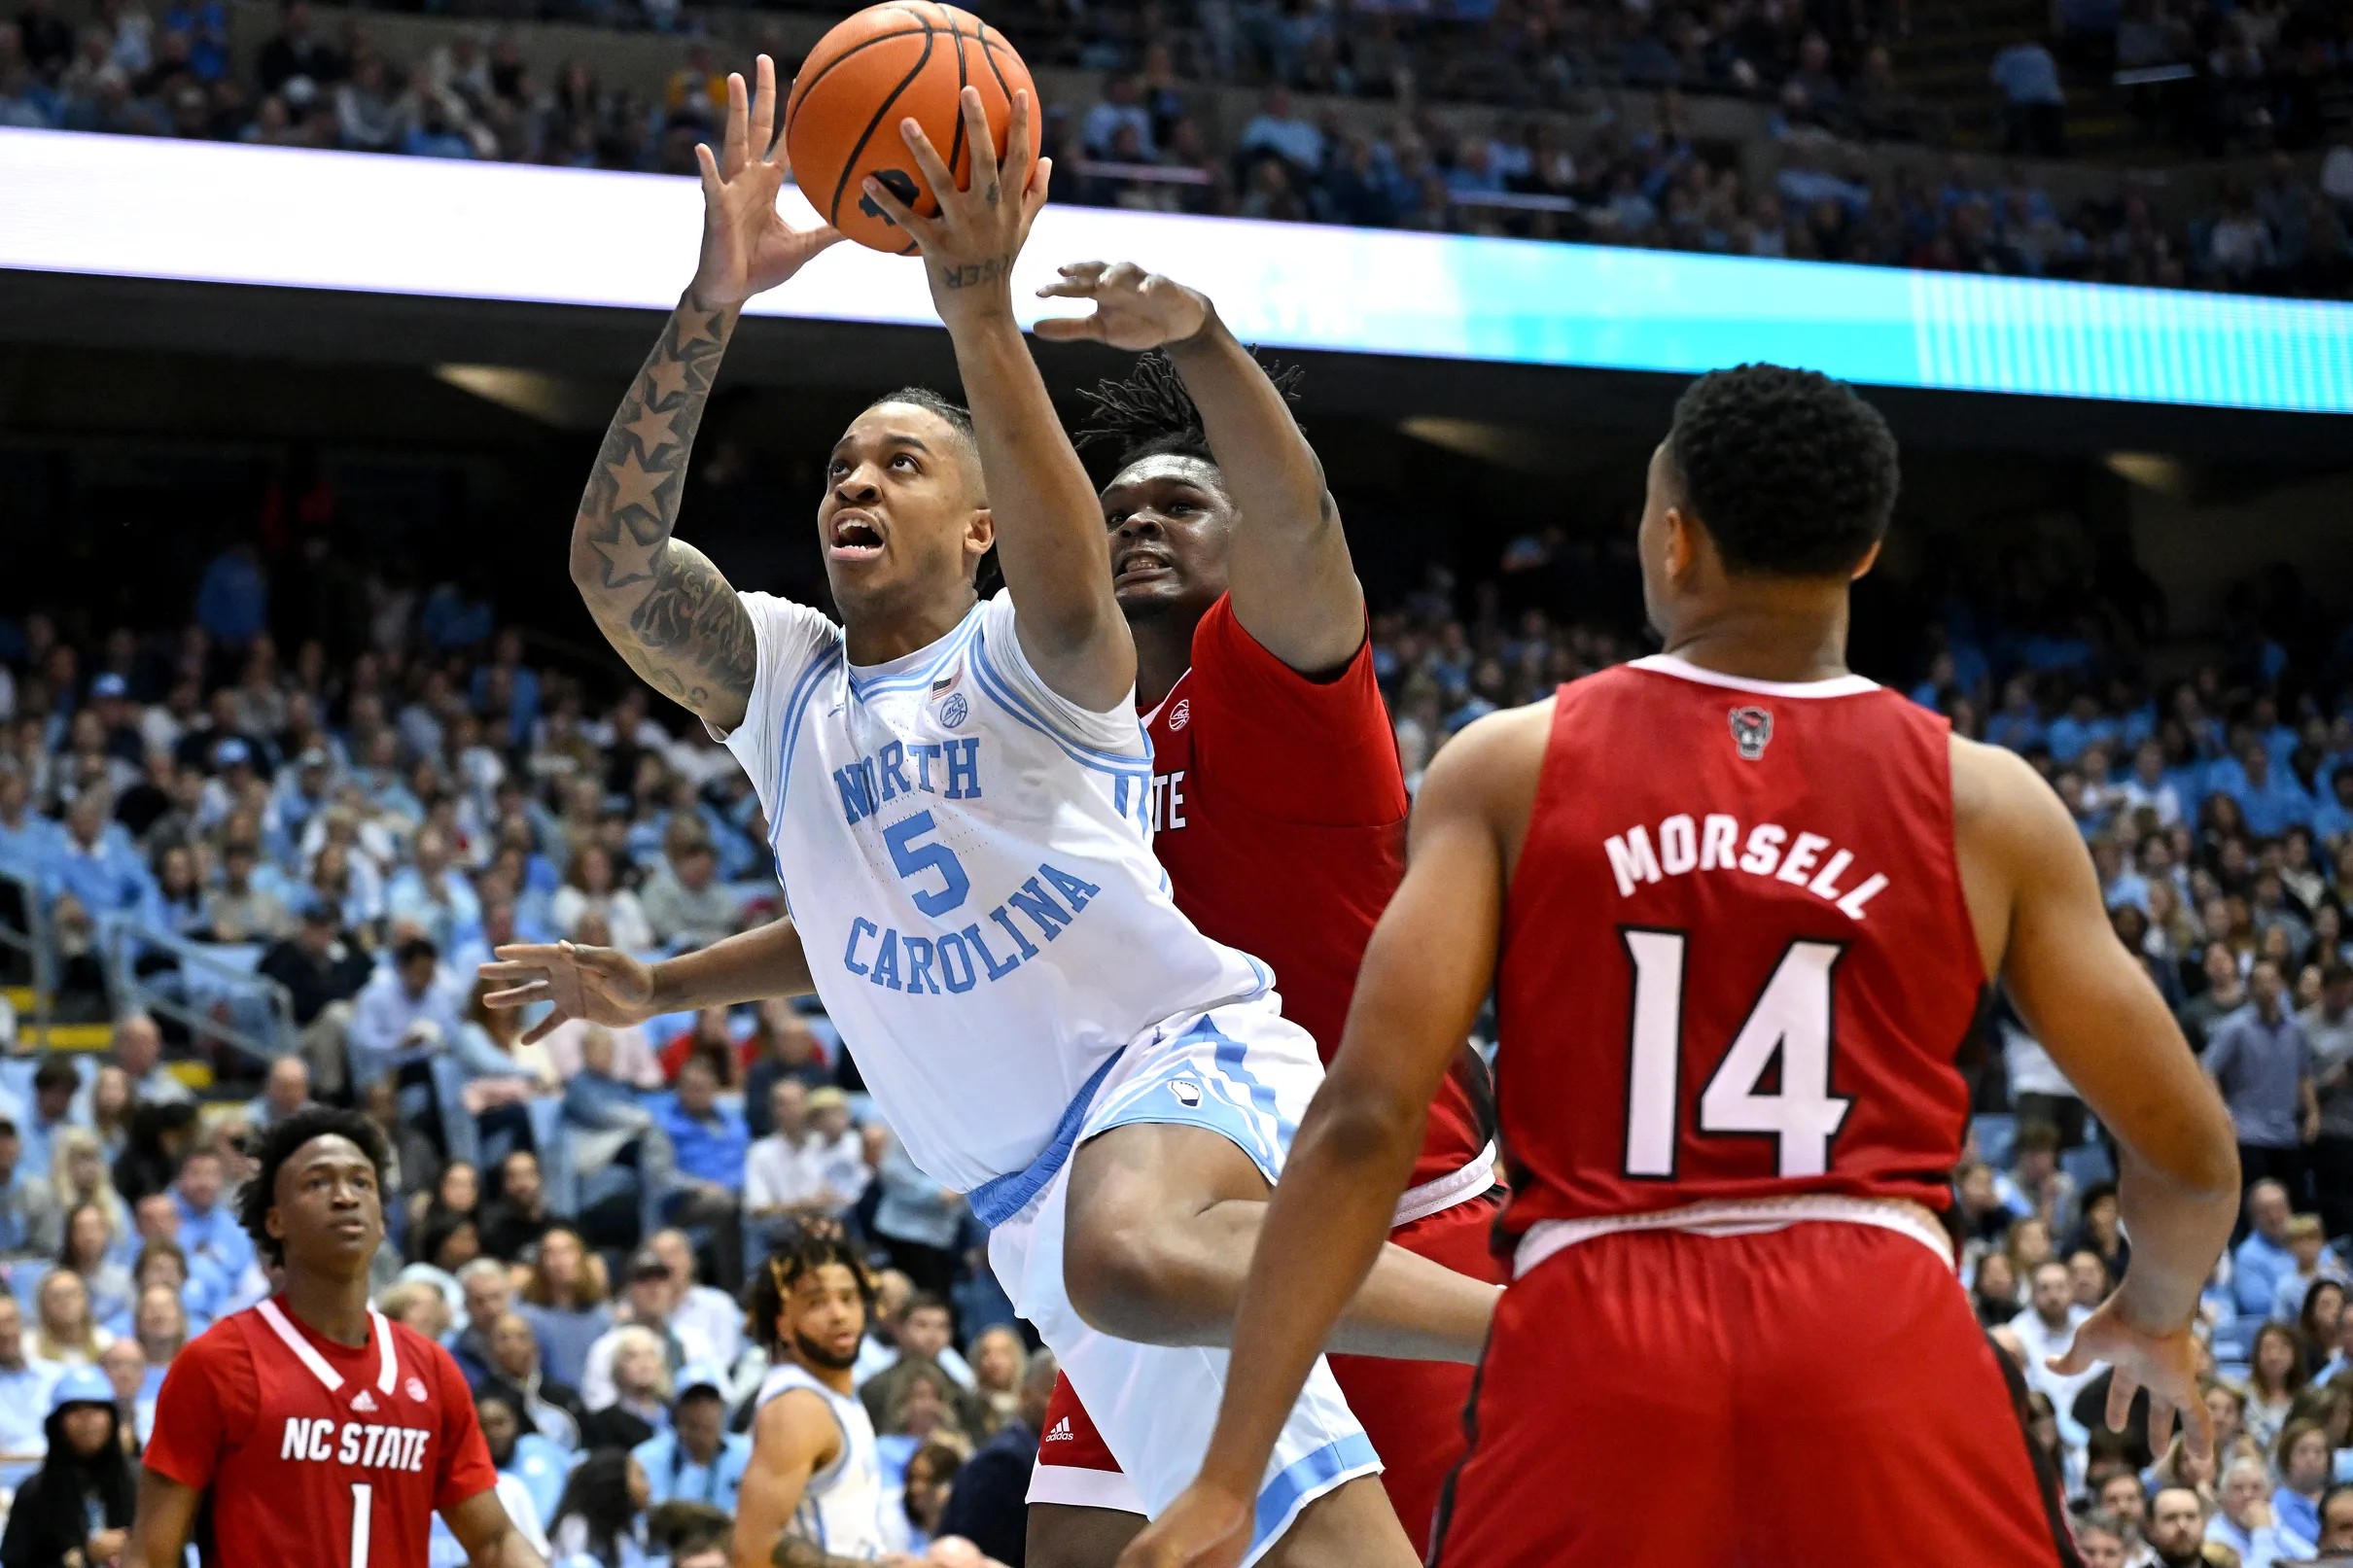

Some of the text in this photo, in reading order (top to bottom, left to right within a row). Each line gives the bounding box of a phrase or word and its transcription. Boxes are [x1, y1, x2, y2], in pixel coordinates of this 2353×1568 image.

[944, 700, 964, 717] ACC
[833, 737, 981, 825] NORTH
[882, 809, 970, 918] 5
[1603, 813, 1889, 921] MORSELL
[844, 863, 1101, 994] CAROLINA
[1618, 924, 1855, 1180] 14
[280, 1416, 431, 1473] NC STATE
[1045, 1431, 1073, 1443] adidas
[350, 1481, 372, 1568] 1
